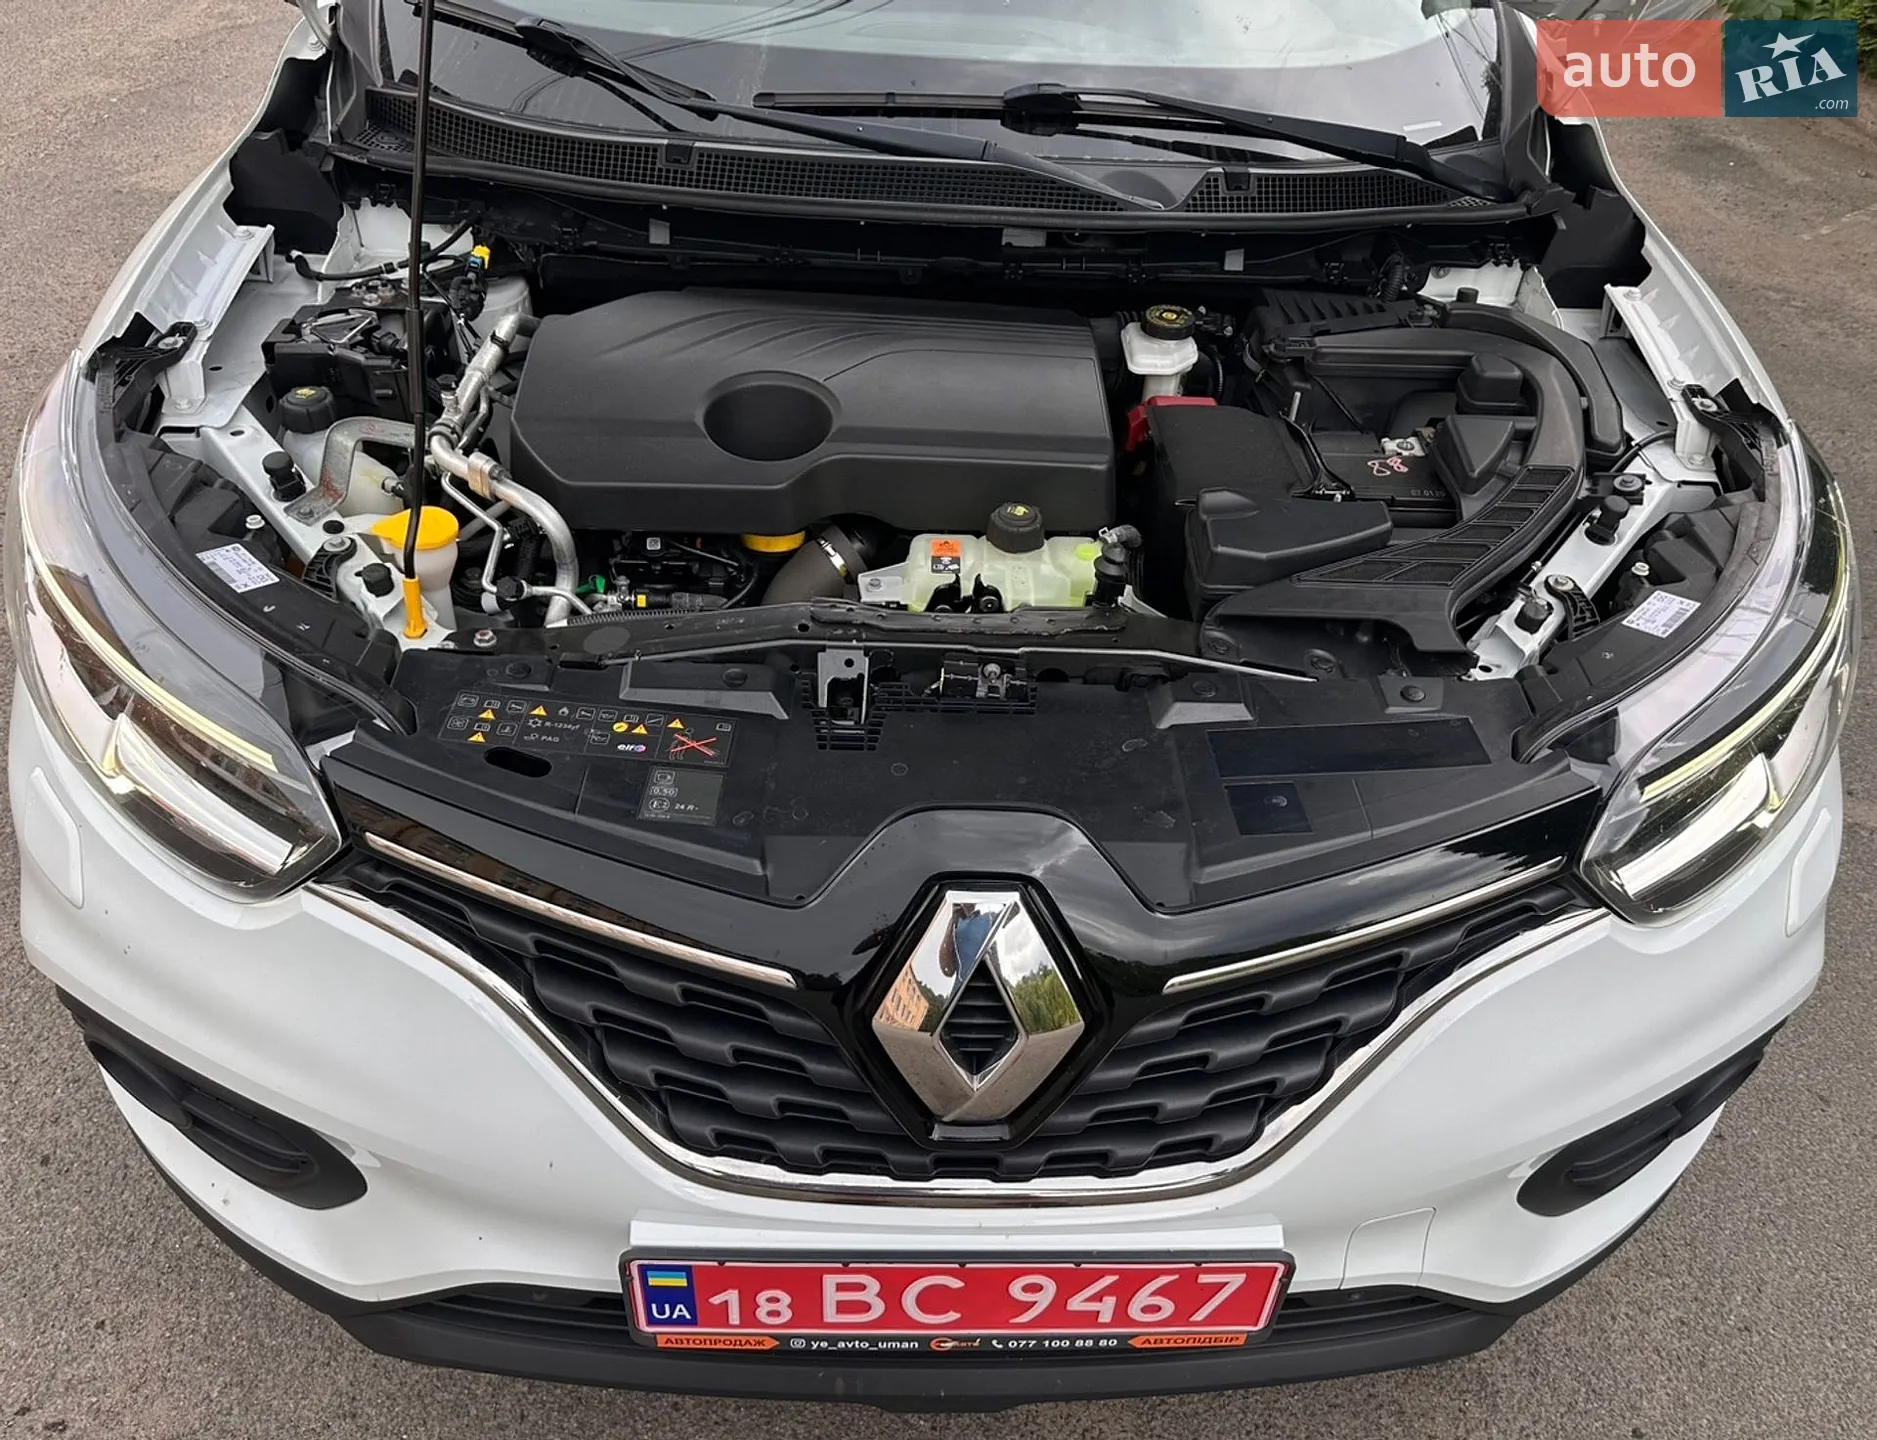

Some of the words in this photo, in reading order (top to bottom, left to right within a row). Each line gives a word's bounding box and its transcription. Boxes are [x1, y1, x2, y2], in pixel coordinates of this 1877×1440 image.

[708, 1288, 793, 1326] 18
[822, 1273, 965, 1325] BC
[1007, 1273, 1247, 1324] 9467
[651, 1303, 691, 1319] UA
[664, 1336, 766, 1348] АВТОПРОДАЖ
[810, 1338, 919, 1350] ye_avto_uman
[1008, 1339, 1038, 1348] 077
[1042, 1339, 1070, 1348] 100
[1074, 1338, 1094, 1348] 88
[1098, 1338, 1118, 1348] 80
[1141, 1335, 1240, 1346] АВТОПІДБІР
